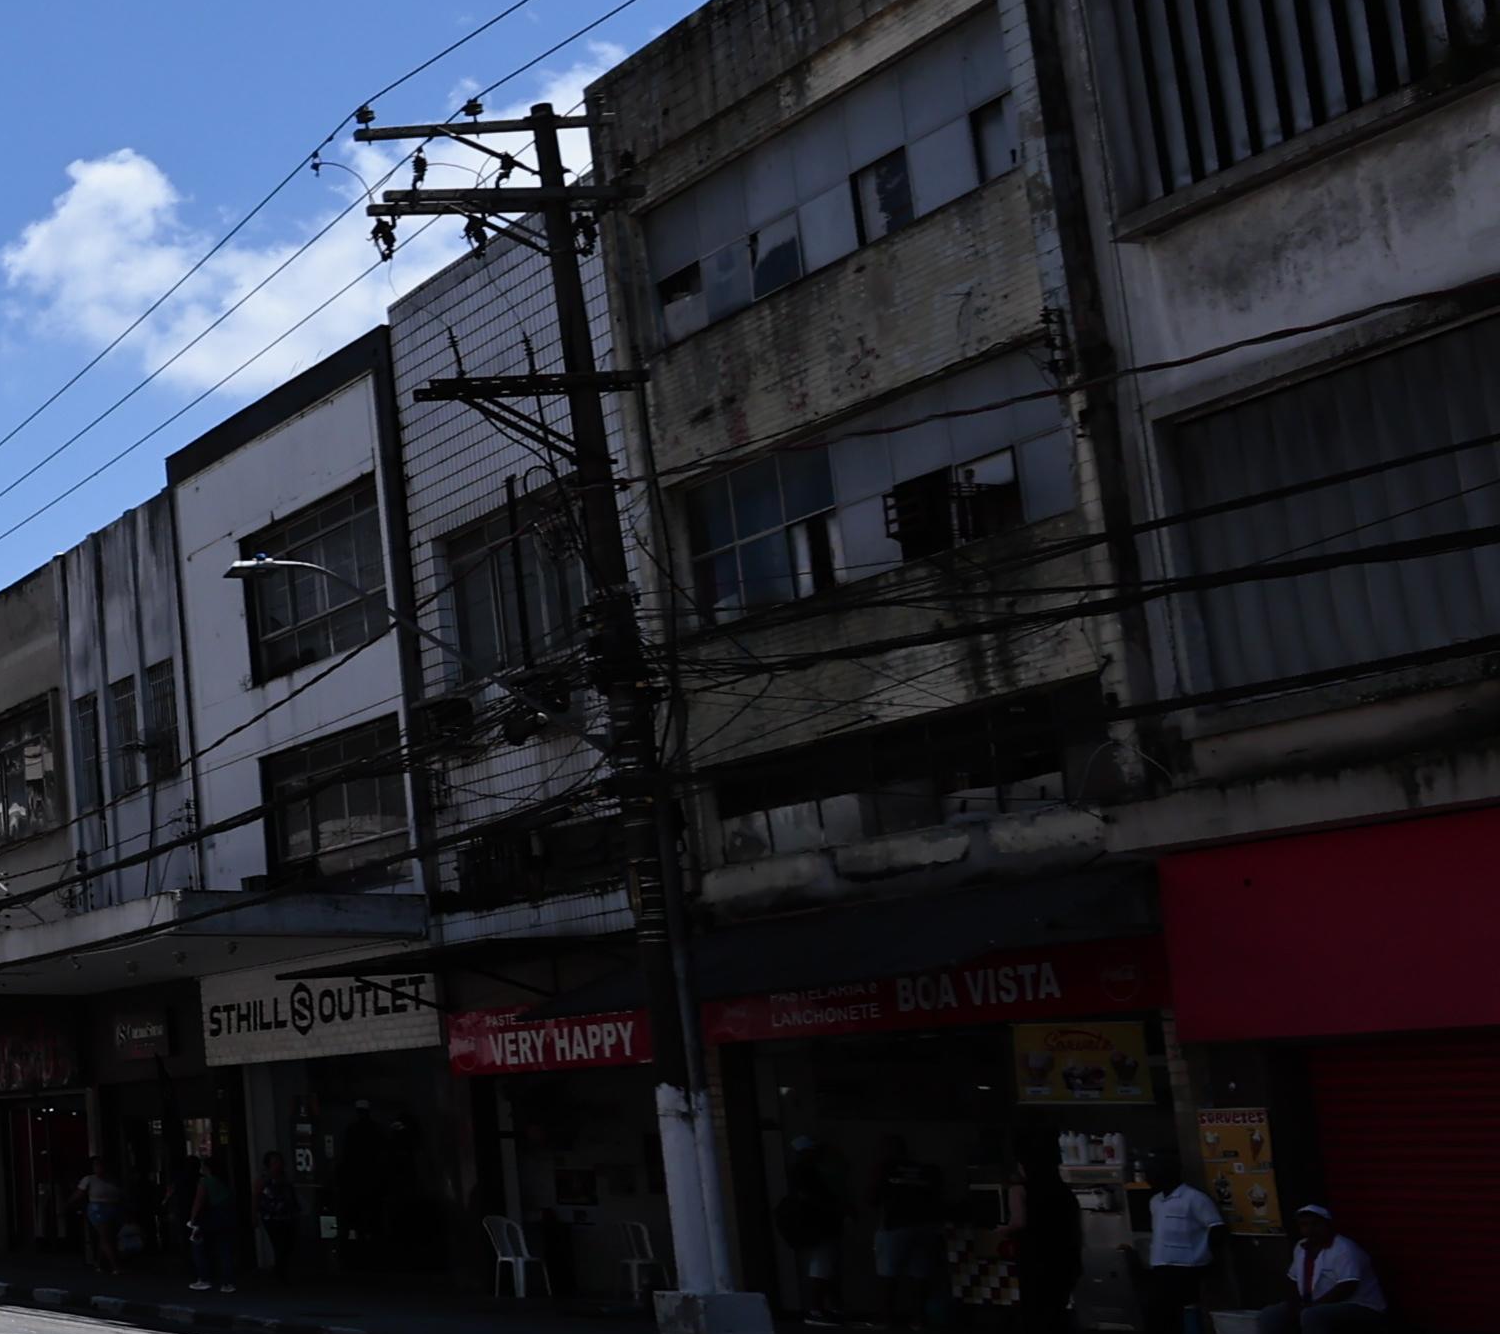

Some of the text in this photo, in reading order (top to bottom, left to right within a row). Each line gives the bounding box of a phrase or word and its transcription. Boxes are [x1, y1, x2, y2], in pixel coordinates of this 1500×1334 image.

[209, 997, 288, 1037] STHILL
[318, 975, 426, 1023] OUTLET
[895, 973, 959, 1013] BOA
[963, 961, 1063, 1007] VISTA
[771, 1002, 885, 1028] LANCHONETE
[488, 1028, 547, 1066] VERY
[553, 1020, 635, 1062] HAPPY
